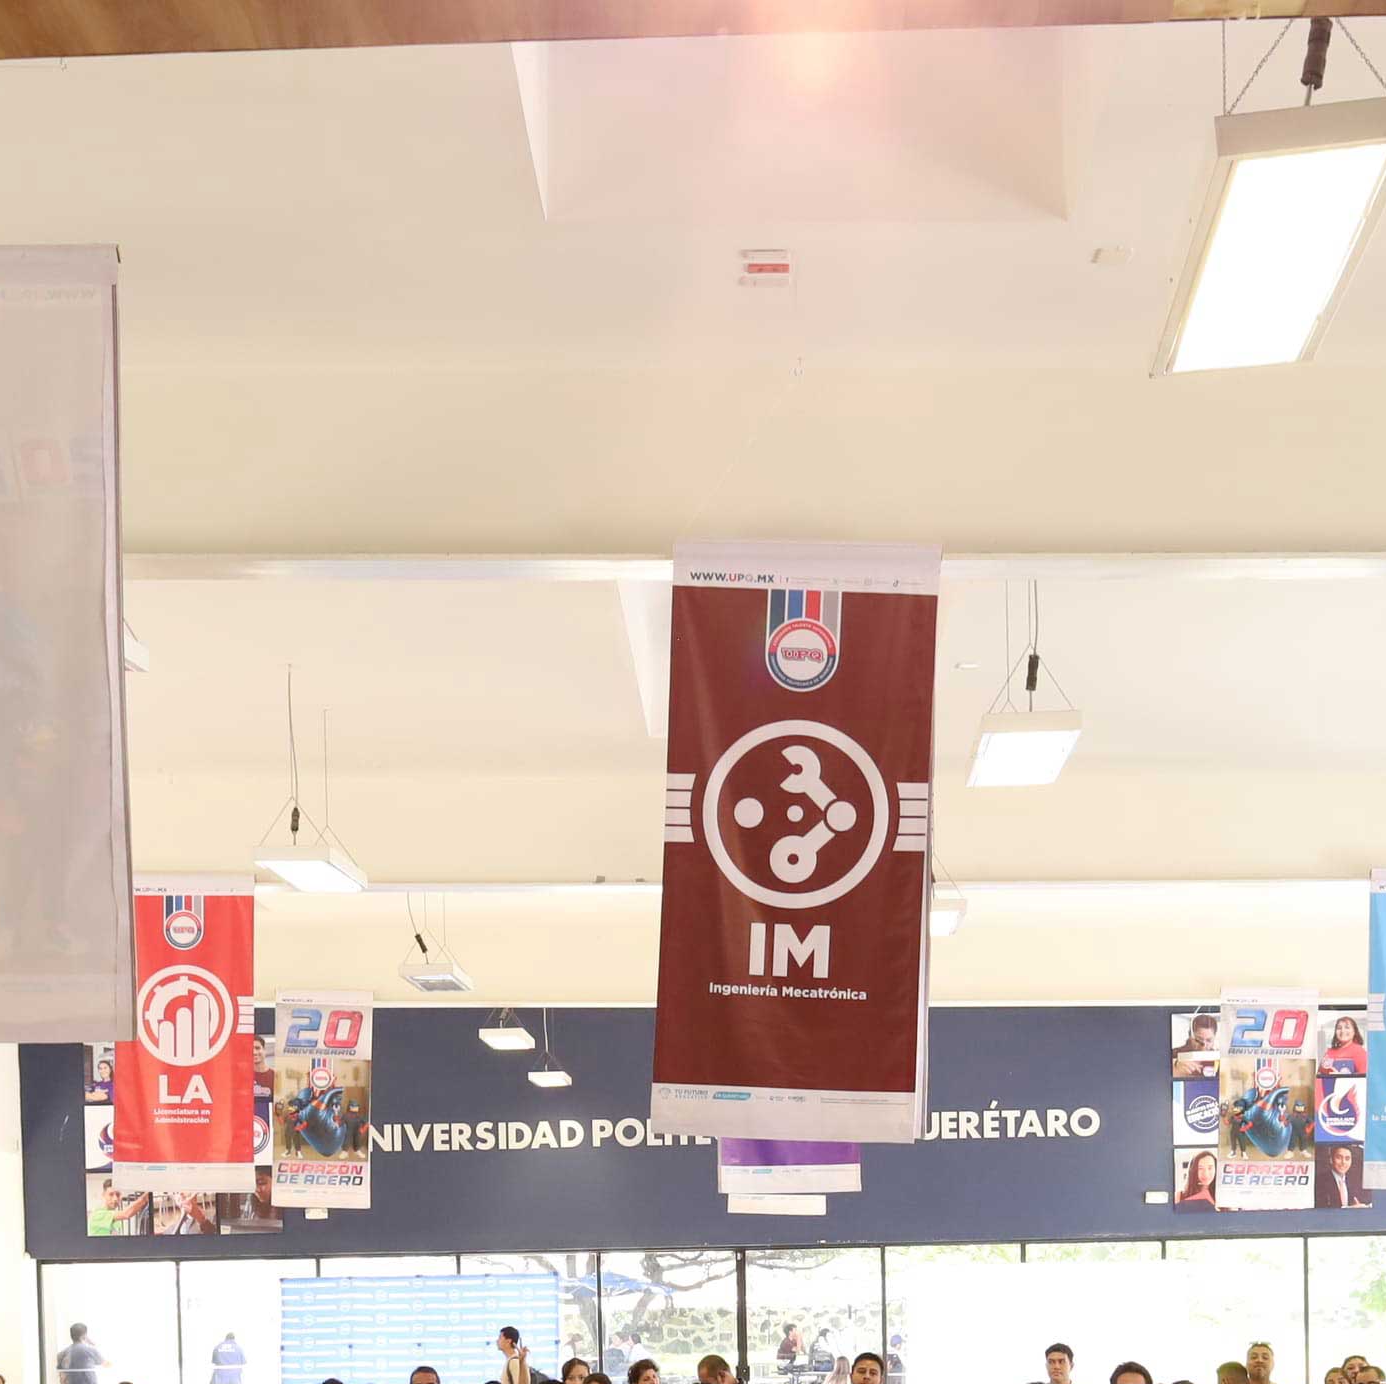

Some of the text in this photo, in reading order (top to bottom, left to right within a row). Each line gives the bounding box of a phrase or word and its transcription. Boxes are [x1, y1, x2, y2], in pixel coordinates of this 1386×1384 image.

[690, 571, 775, 584] WWW.UPQ.MX
[781, 647, 825, 664] UPQ
[749, 922, 831, 979] IM
[709, 982, 868, 1001] Ingeniería Mecatrónica
[285, 1009, 364, 1049] 20
[1229, 1009, 1310, 1049] 20
[283, 1047, 357, 1056] ANIVERSARIO
[1228, 1047, 1303, 1057] ANIVERSARIO
[158, 1074, 214, 1104] LA
[154, 1116, 210, 1124] Administración
[370, 1119, 584, 1152] NIVERSIDAD
[924, 1100, 1101, 1140] UERÉTARO
[277, 1161, 363, 1175] CORAZÓN
[1222, 1161, 1309, 1175] CORAZÓN
[276, 1174, 364, 1186] DE ACERO
[1222, 1174, 1310, 1187] DE ACERO
